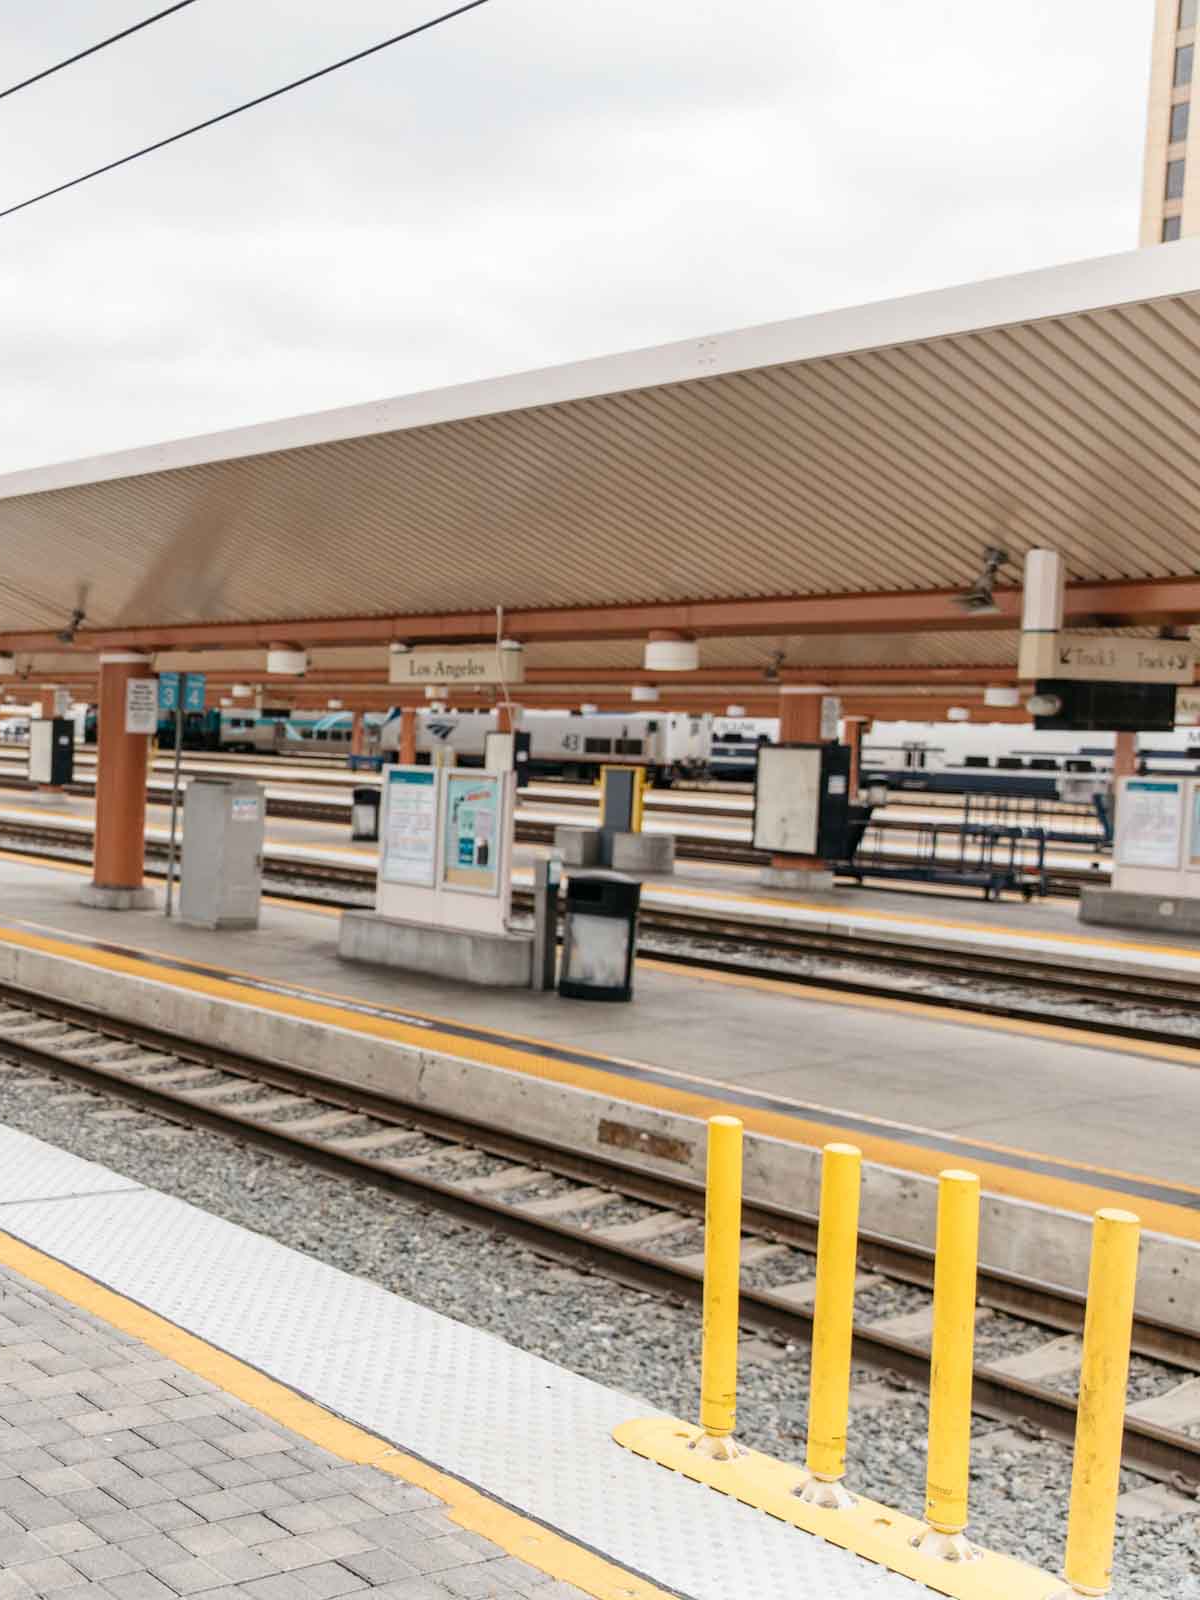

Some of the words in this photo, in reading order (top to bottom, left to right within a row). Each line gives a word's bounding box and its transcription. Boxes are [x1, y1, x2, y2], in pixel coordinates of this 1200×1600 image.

[409, 659, 432, 676] Los
[434, 658, 485, 679] Angeles
[164, 688, 175, 705] 3
[187, 690, 200, 705] 4
